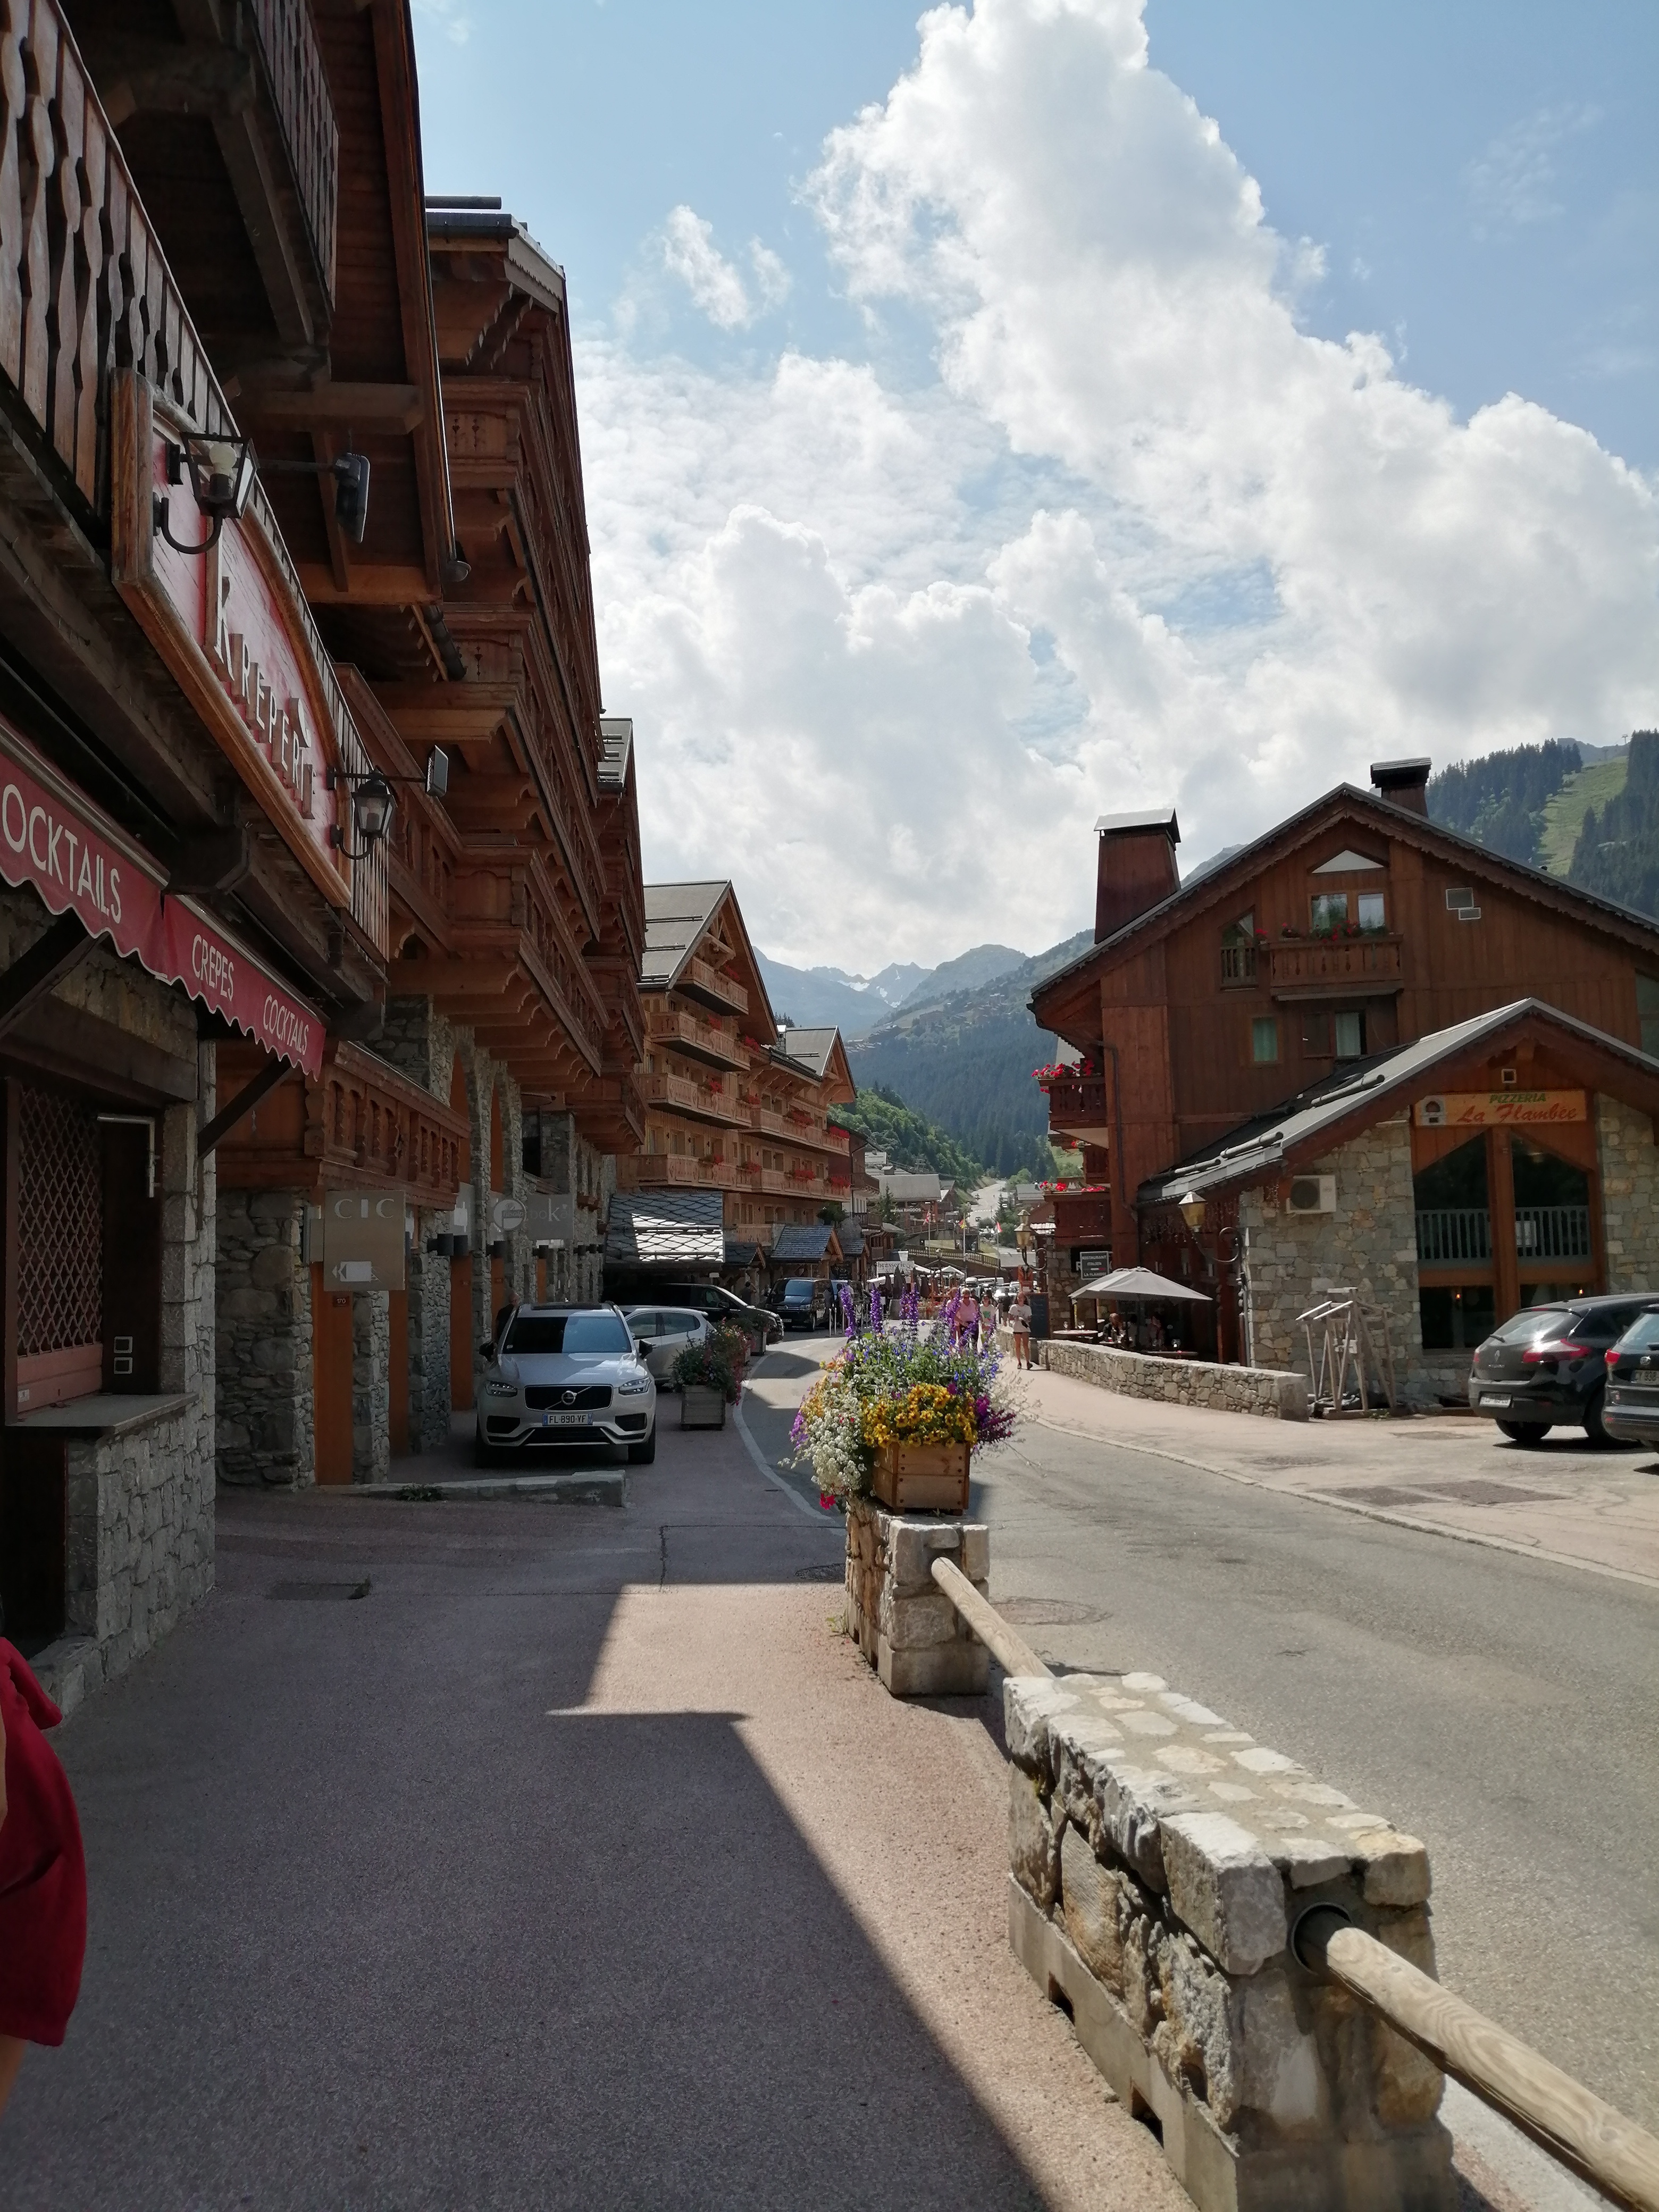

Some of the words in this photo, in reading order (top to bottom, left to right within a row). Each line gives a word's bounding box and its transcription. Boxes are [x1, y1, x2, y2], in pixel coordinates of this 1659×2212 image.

[0, 783, 123, 924] OCKTAILS
[191, 934, 234, 1002] CREPES
[263, 994, 309, 1057] COCKTAILS
[1489, 1093, 1546, 1103] PIZZERIA
[1457, 1105, 1486, 1123] La
[1495, 1102, 1578, 1123] Flambée
[334, 1198, 395, 1219] CIC
[549, 1415, 586, 1423] FL-890-YF
